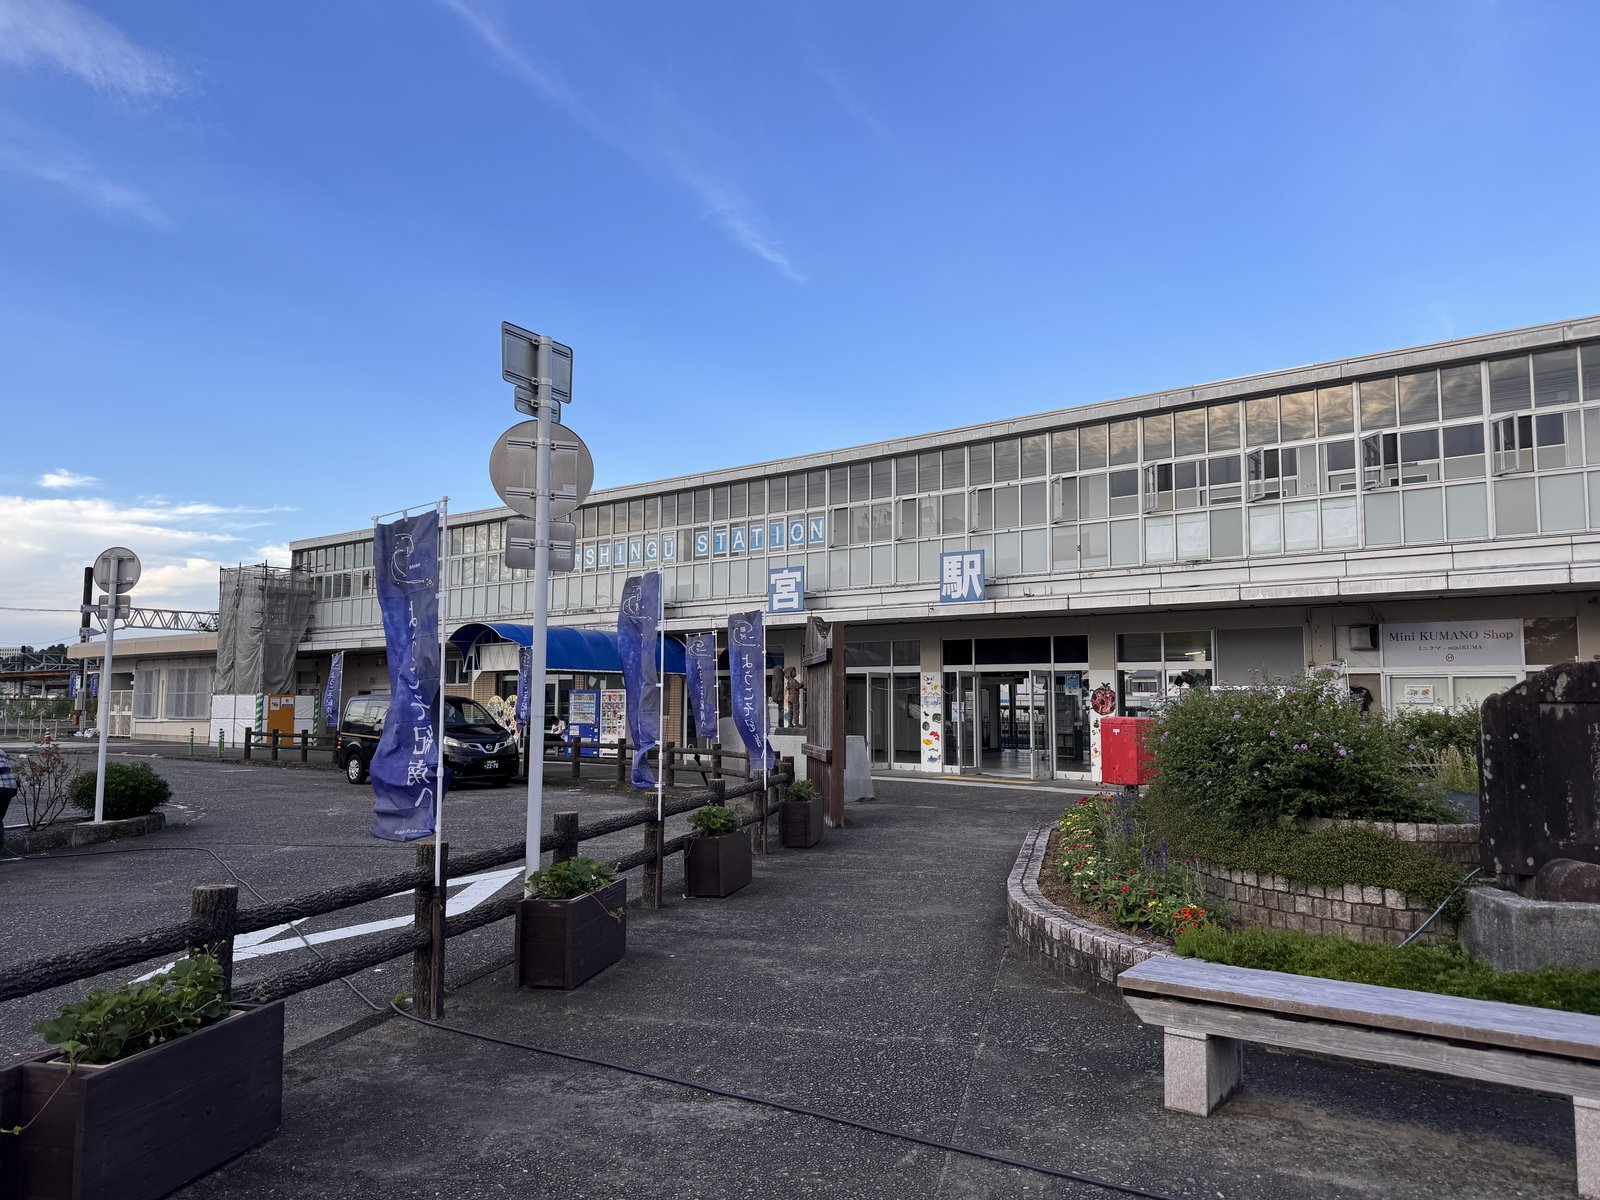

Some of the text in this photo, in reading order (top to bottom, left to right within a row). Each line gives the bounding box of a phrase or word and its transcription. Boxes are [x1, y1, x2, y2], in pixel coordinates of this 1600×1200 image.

[697, 519, 823, 552] STATION
[770, 553, 982, 609] 宮 駅
[1389, 629, 1514, 642] Mini KUMANO Shop
